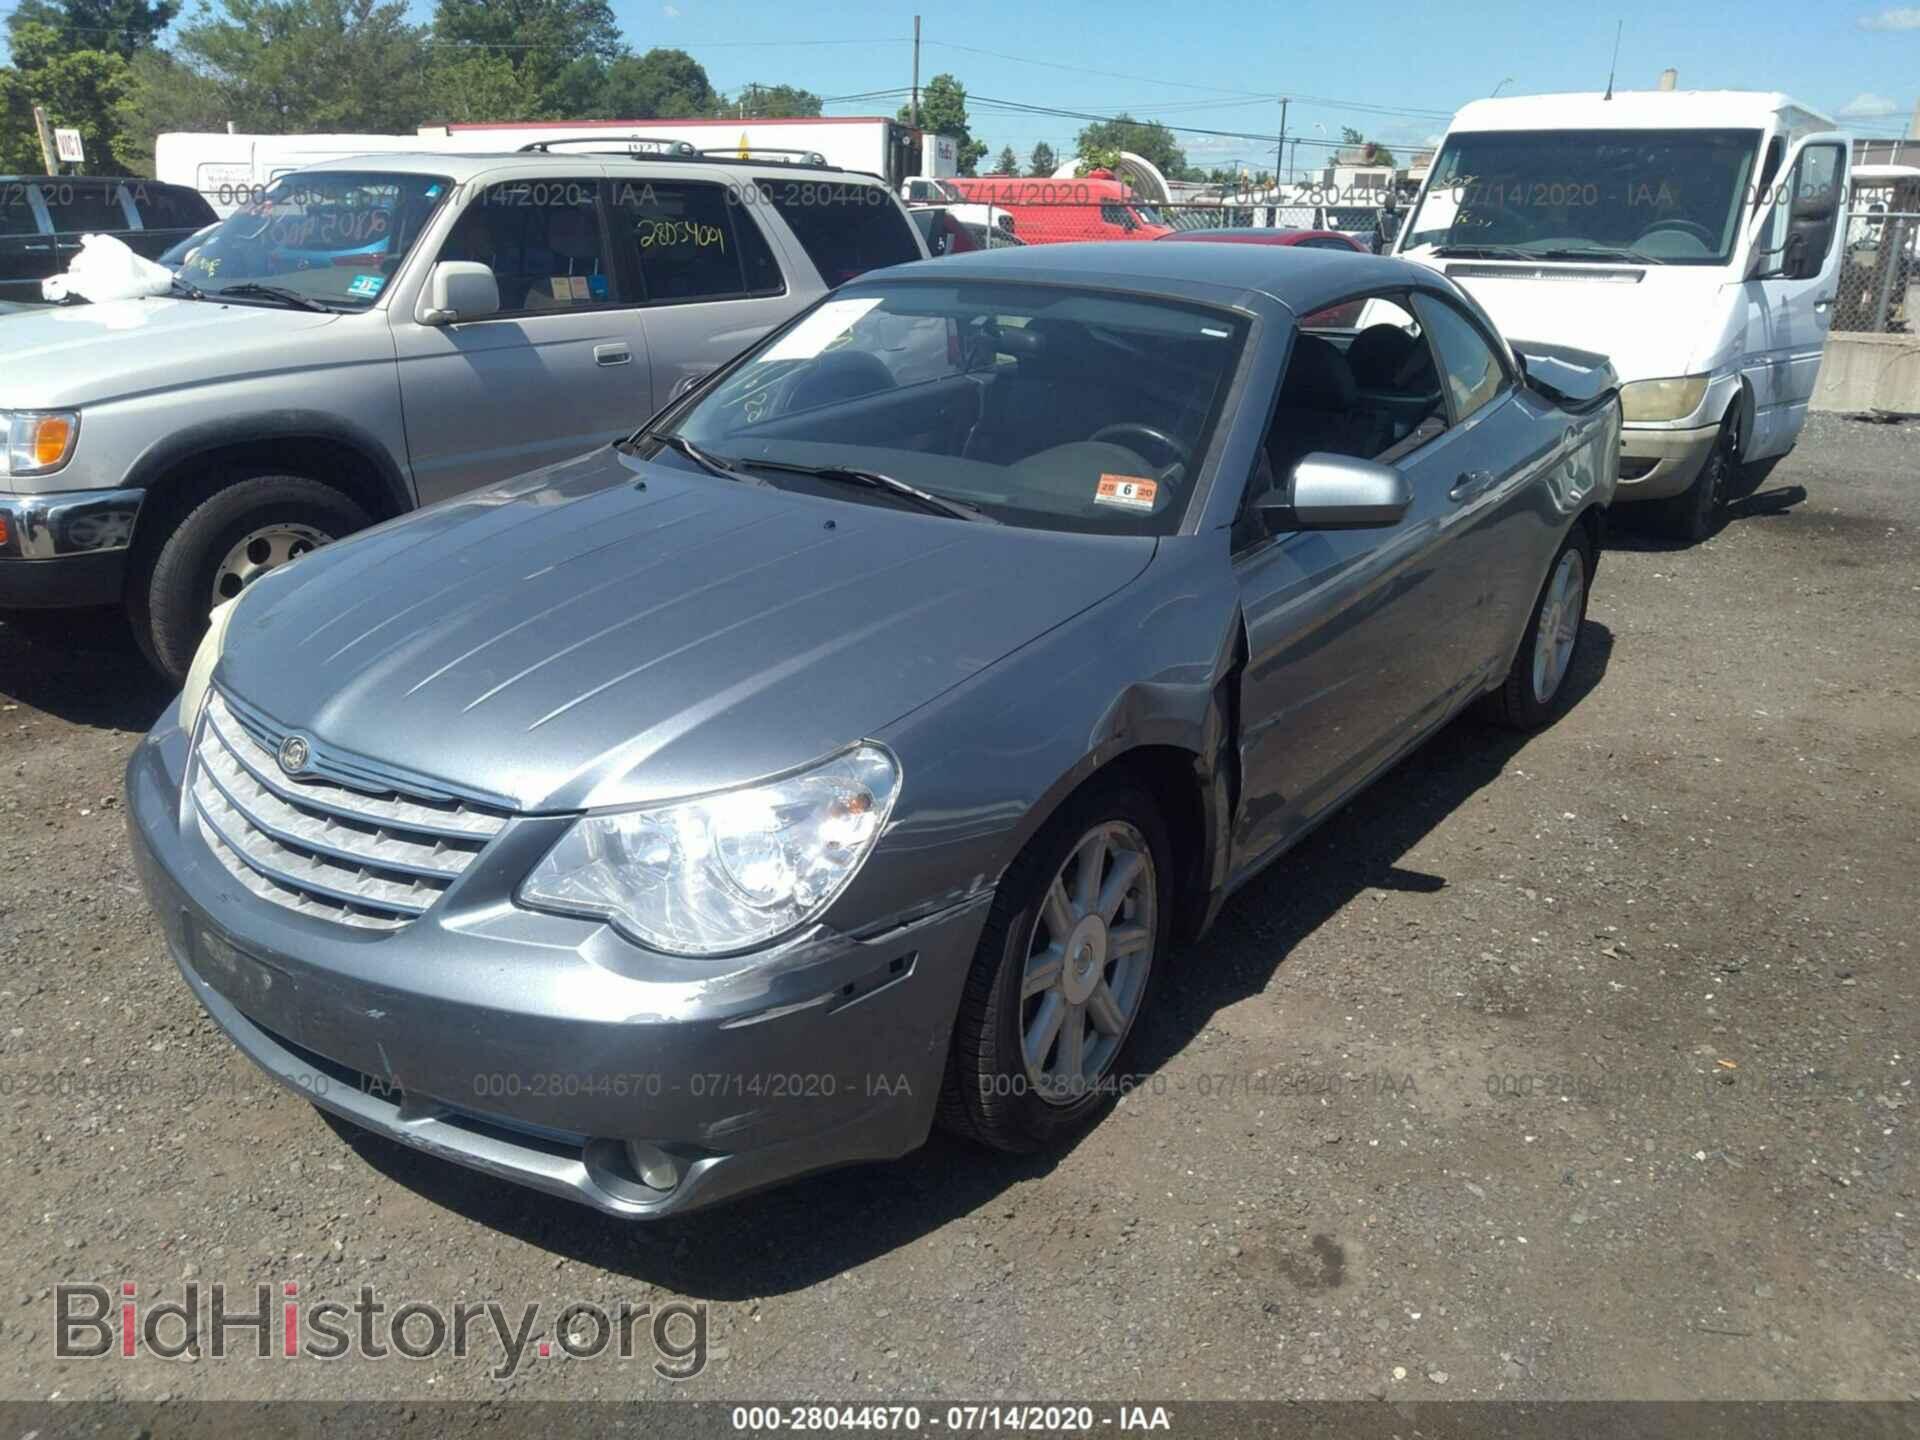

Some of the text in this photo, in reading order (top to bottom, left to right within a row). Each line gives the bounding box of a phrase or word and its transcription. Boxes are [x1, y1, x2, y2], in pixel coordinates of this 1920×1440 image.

[1102, 483, 1153, 497] 20 6 20
